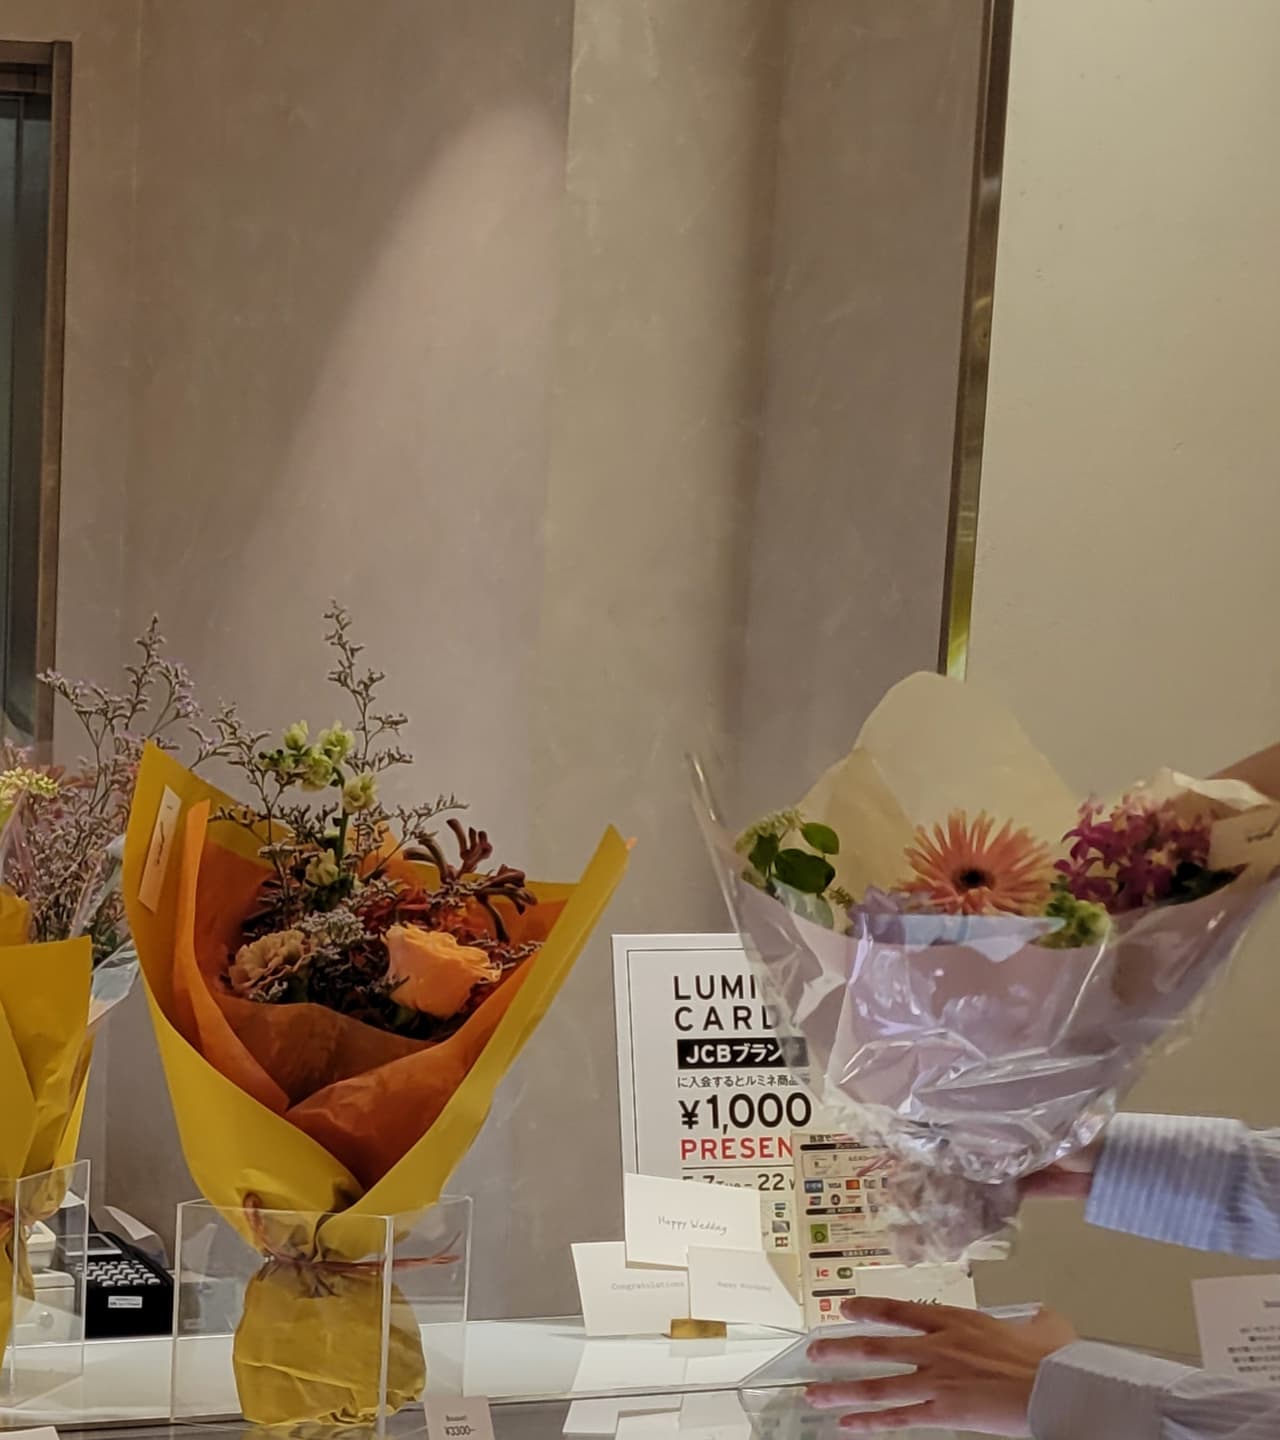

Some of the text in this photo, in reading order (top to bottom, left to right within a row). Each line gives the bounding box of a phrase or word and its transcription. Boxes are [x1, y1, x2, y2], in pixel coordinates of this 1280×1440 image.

[672, 973, 757, 1001] LUMI
[685, 1042, 801, 1064] JCBブラン
[677, 1091, 813, 1136] ¥1,000
[679, 1135, 794, 1161] PRESEN
